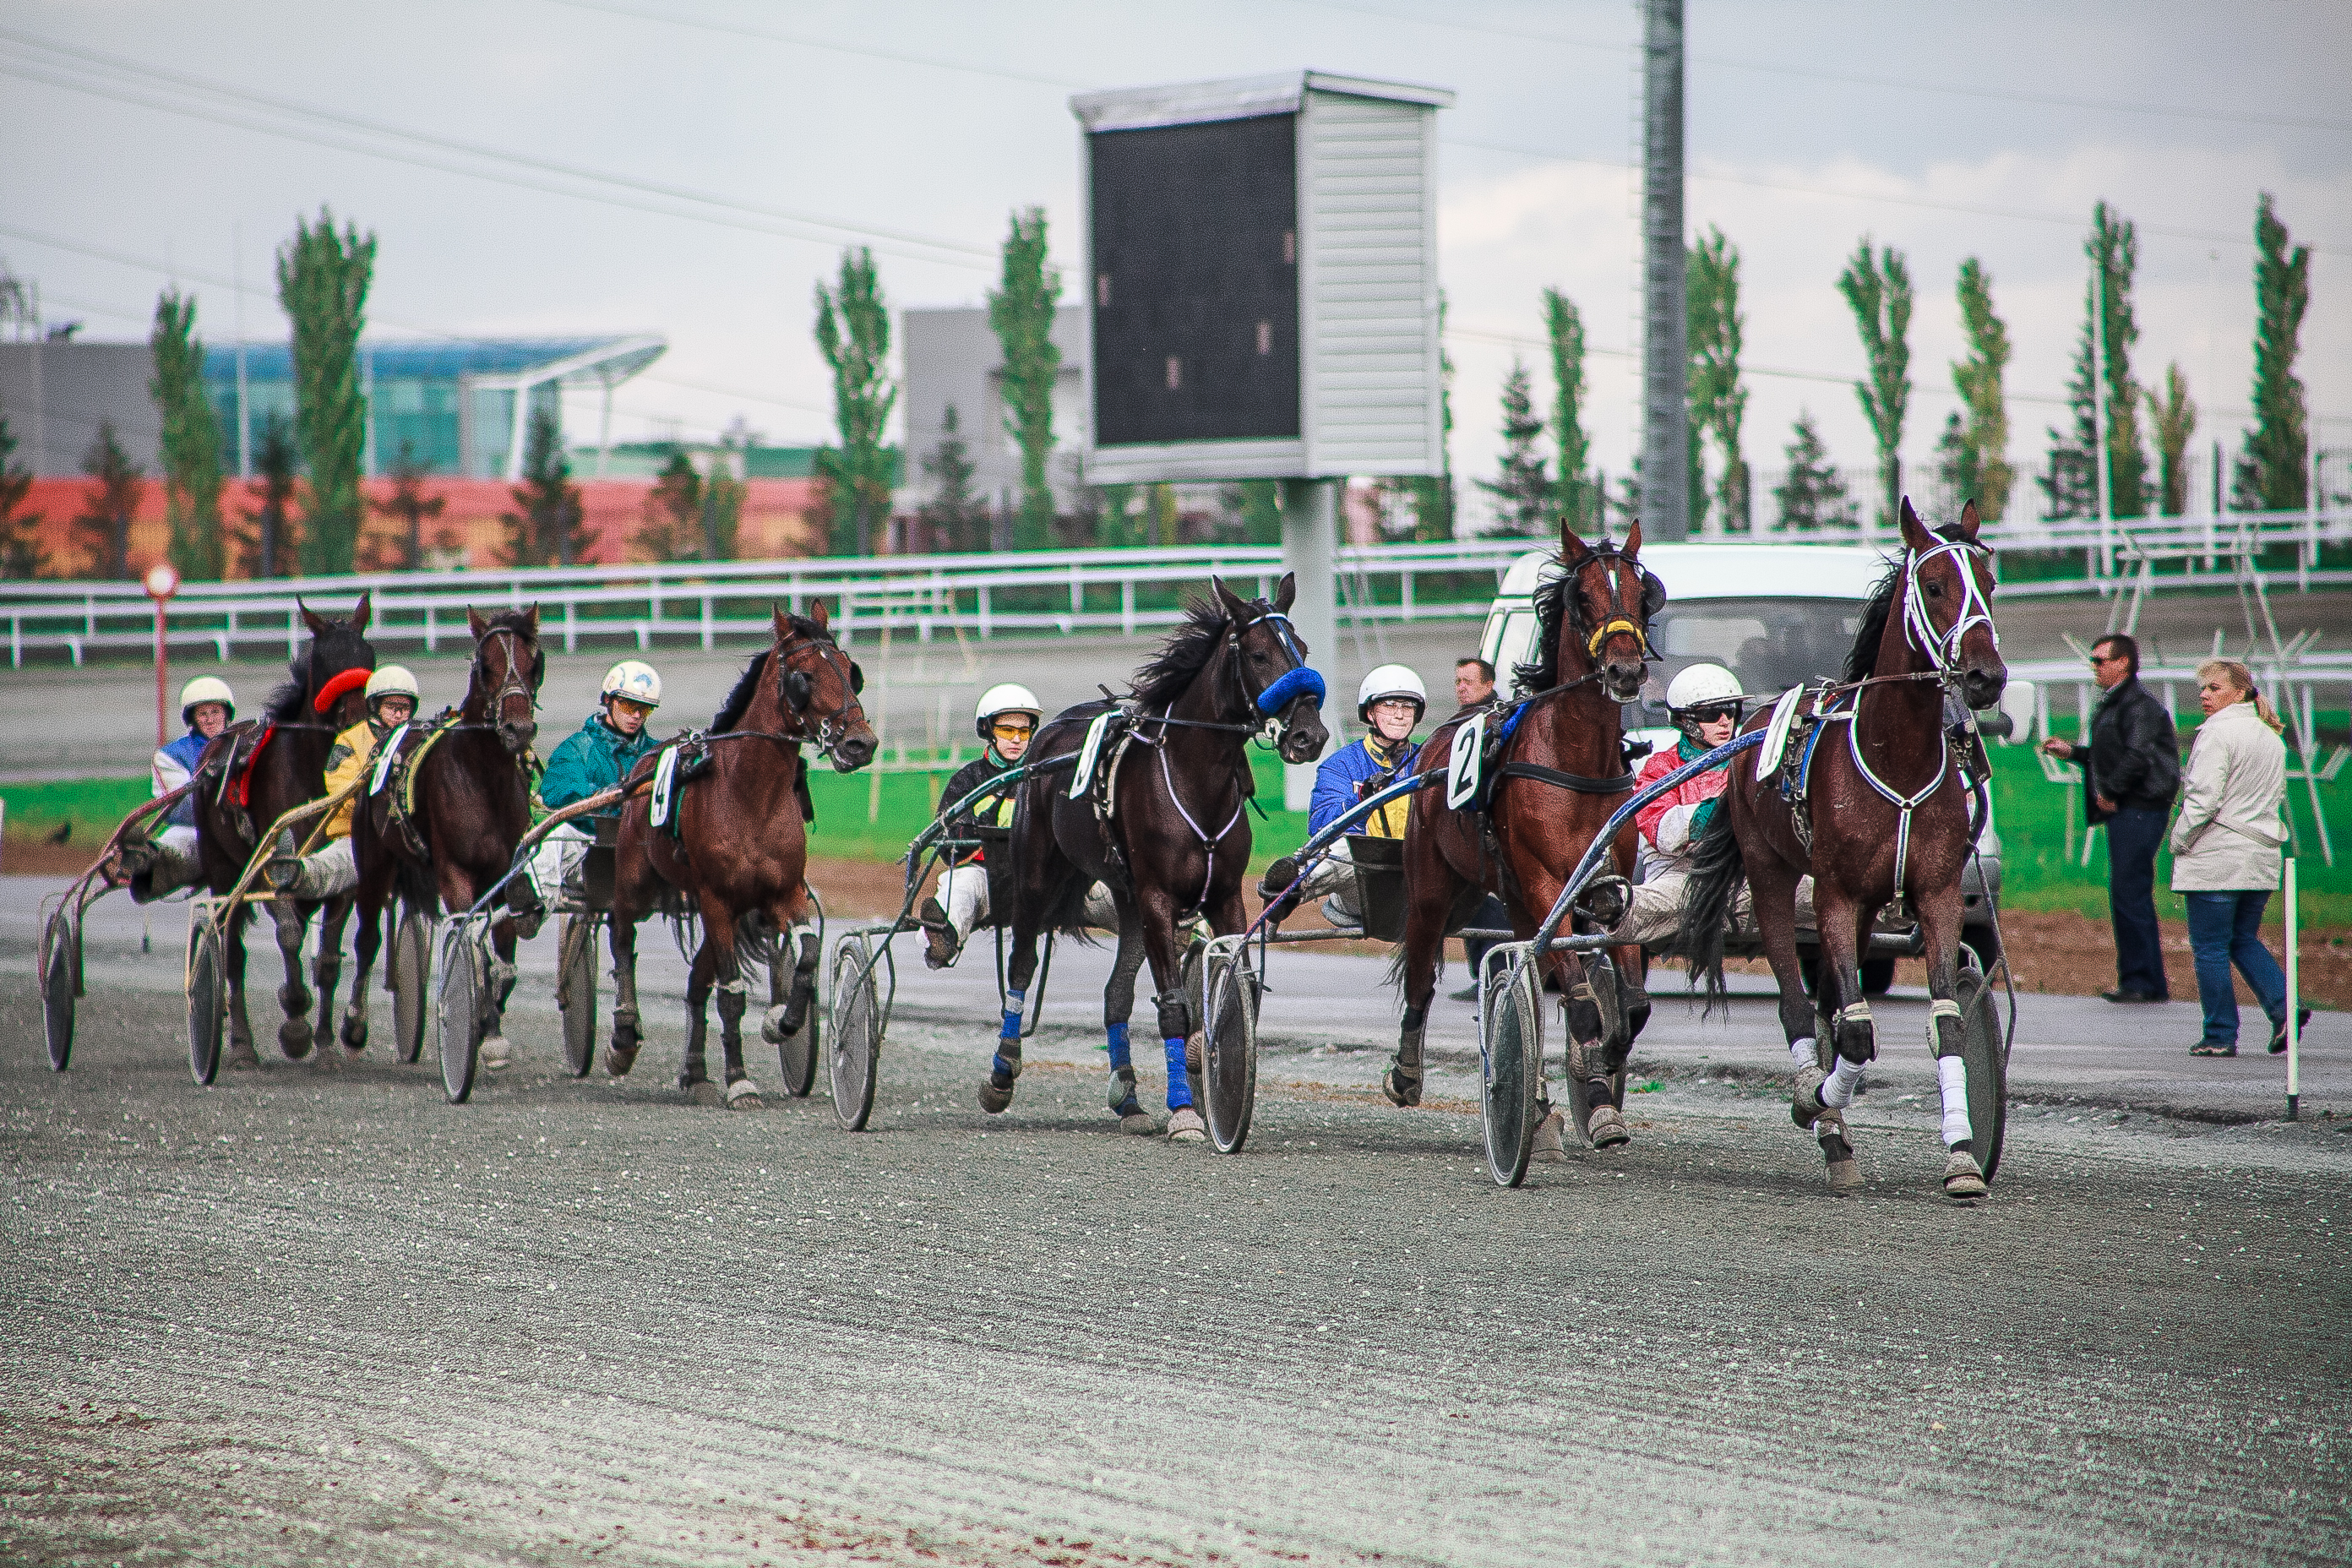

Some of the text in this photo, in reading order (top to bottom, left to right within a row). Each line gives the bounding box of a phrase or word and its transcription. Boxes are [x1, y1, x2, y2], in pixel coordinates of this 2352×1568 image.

[655, 757, 672, 817] 4
[1076, 722, 1101, 787] 3
[1451, 727, 1476, 801] 2
